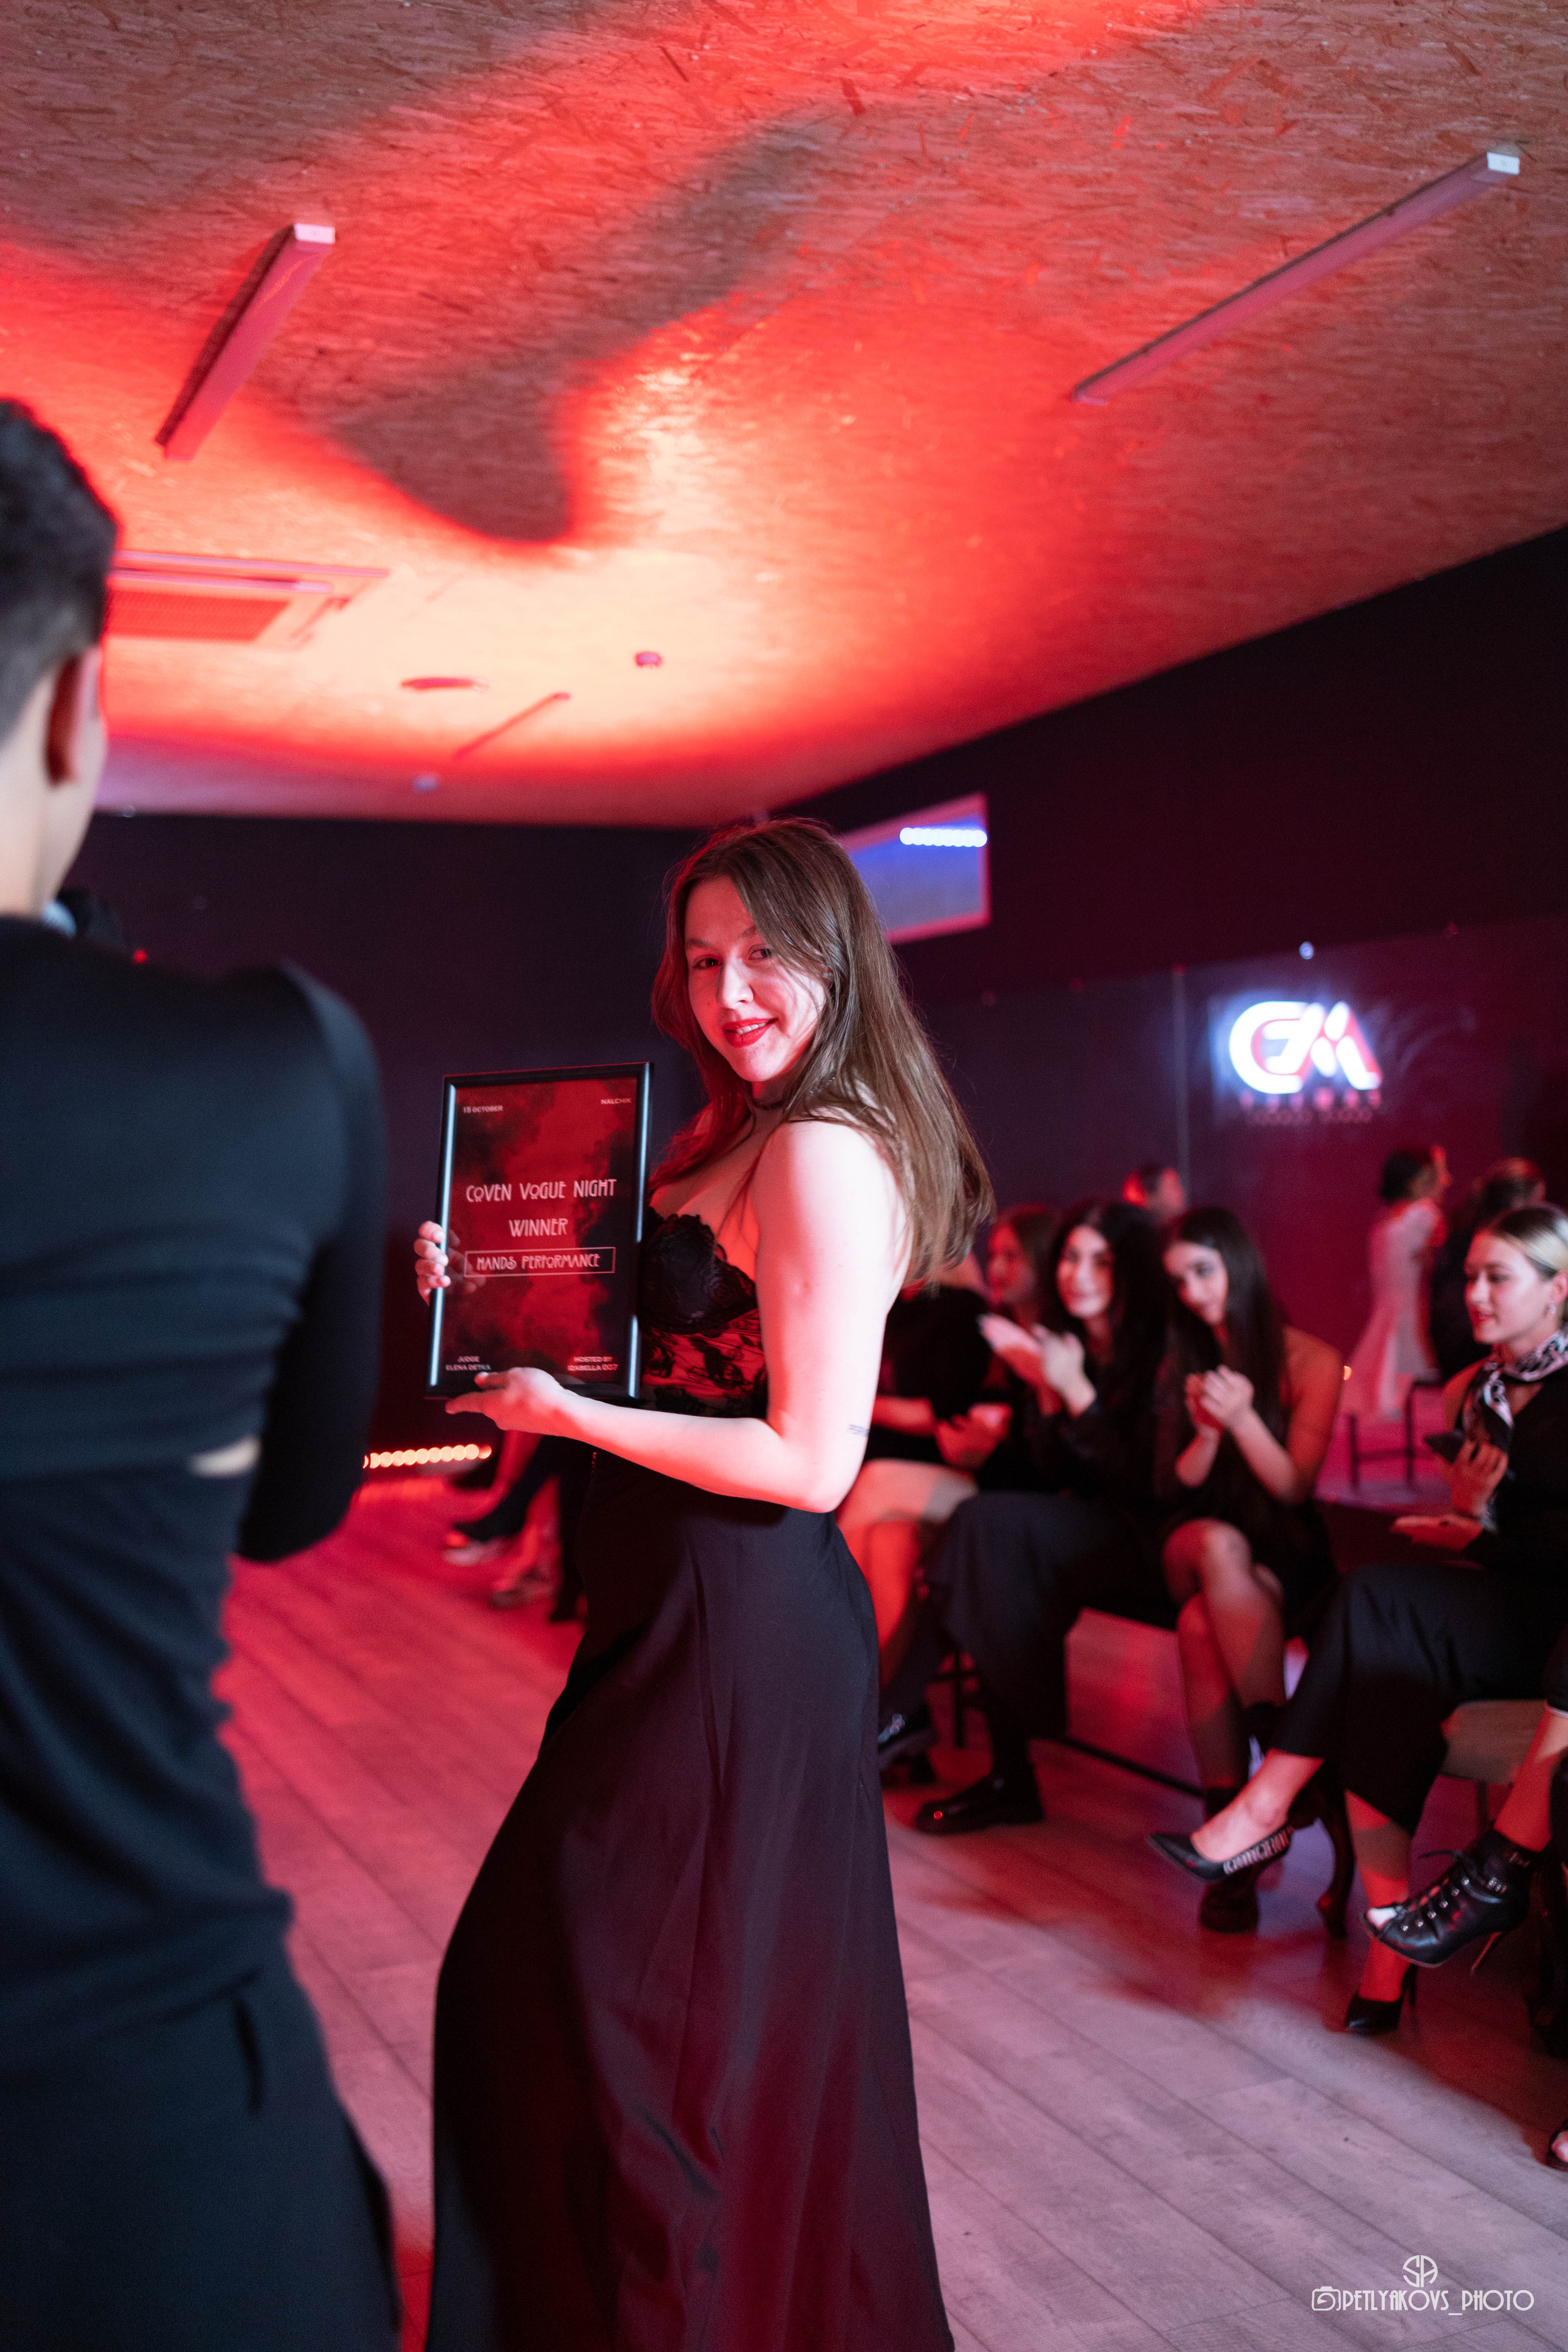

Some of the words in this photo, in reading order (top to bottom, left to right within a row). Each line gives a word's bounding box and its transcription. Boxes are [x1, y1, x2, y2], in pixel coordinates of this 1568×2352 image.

[466, 1183, 512, 1202] COVEN
[519, 1181, 567, 1200] VOGUE
[573, 1179, 617, 1197] NIGHT
[508, 1218, 568, 1237] WINNER
[477, 1256, 517, 1271] HANDS
[521, 1254, 601, 1270] PERFORMANCE
